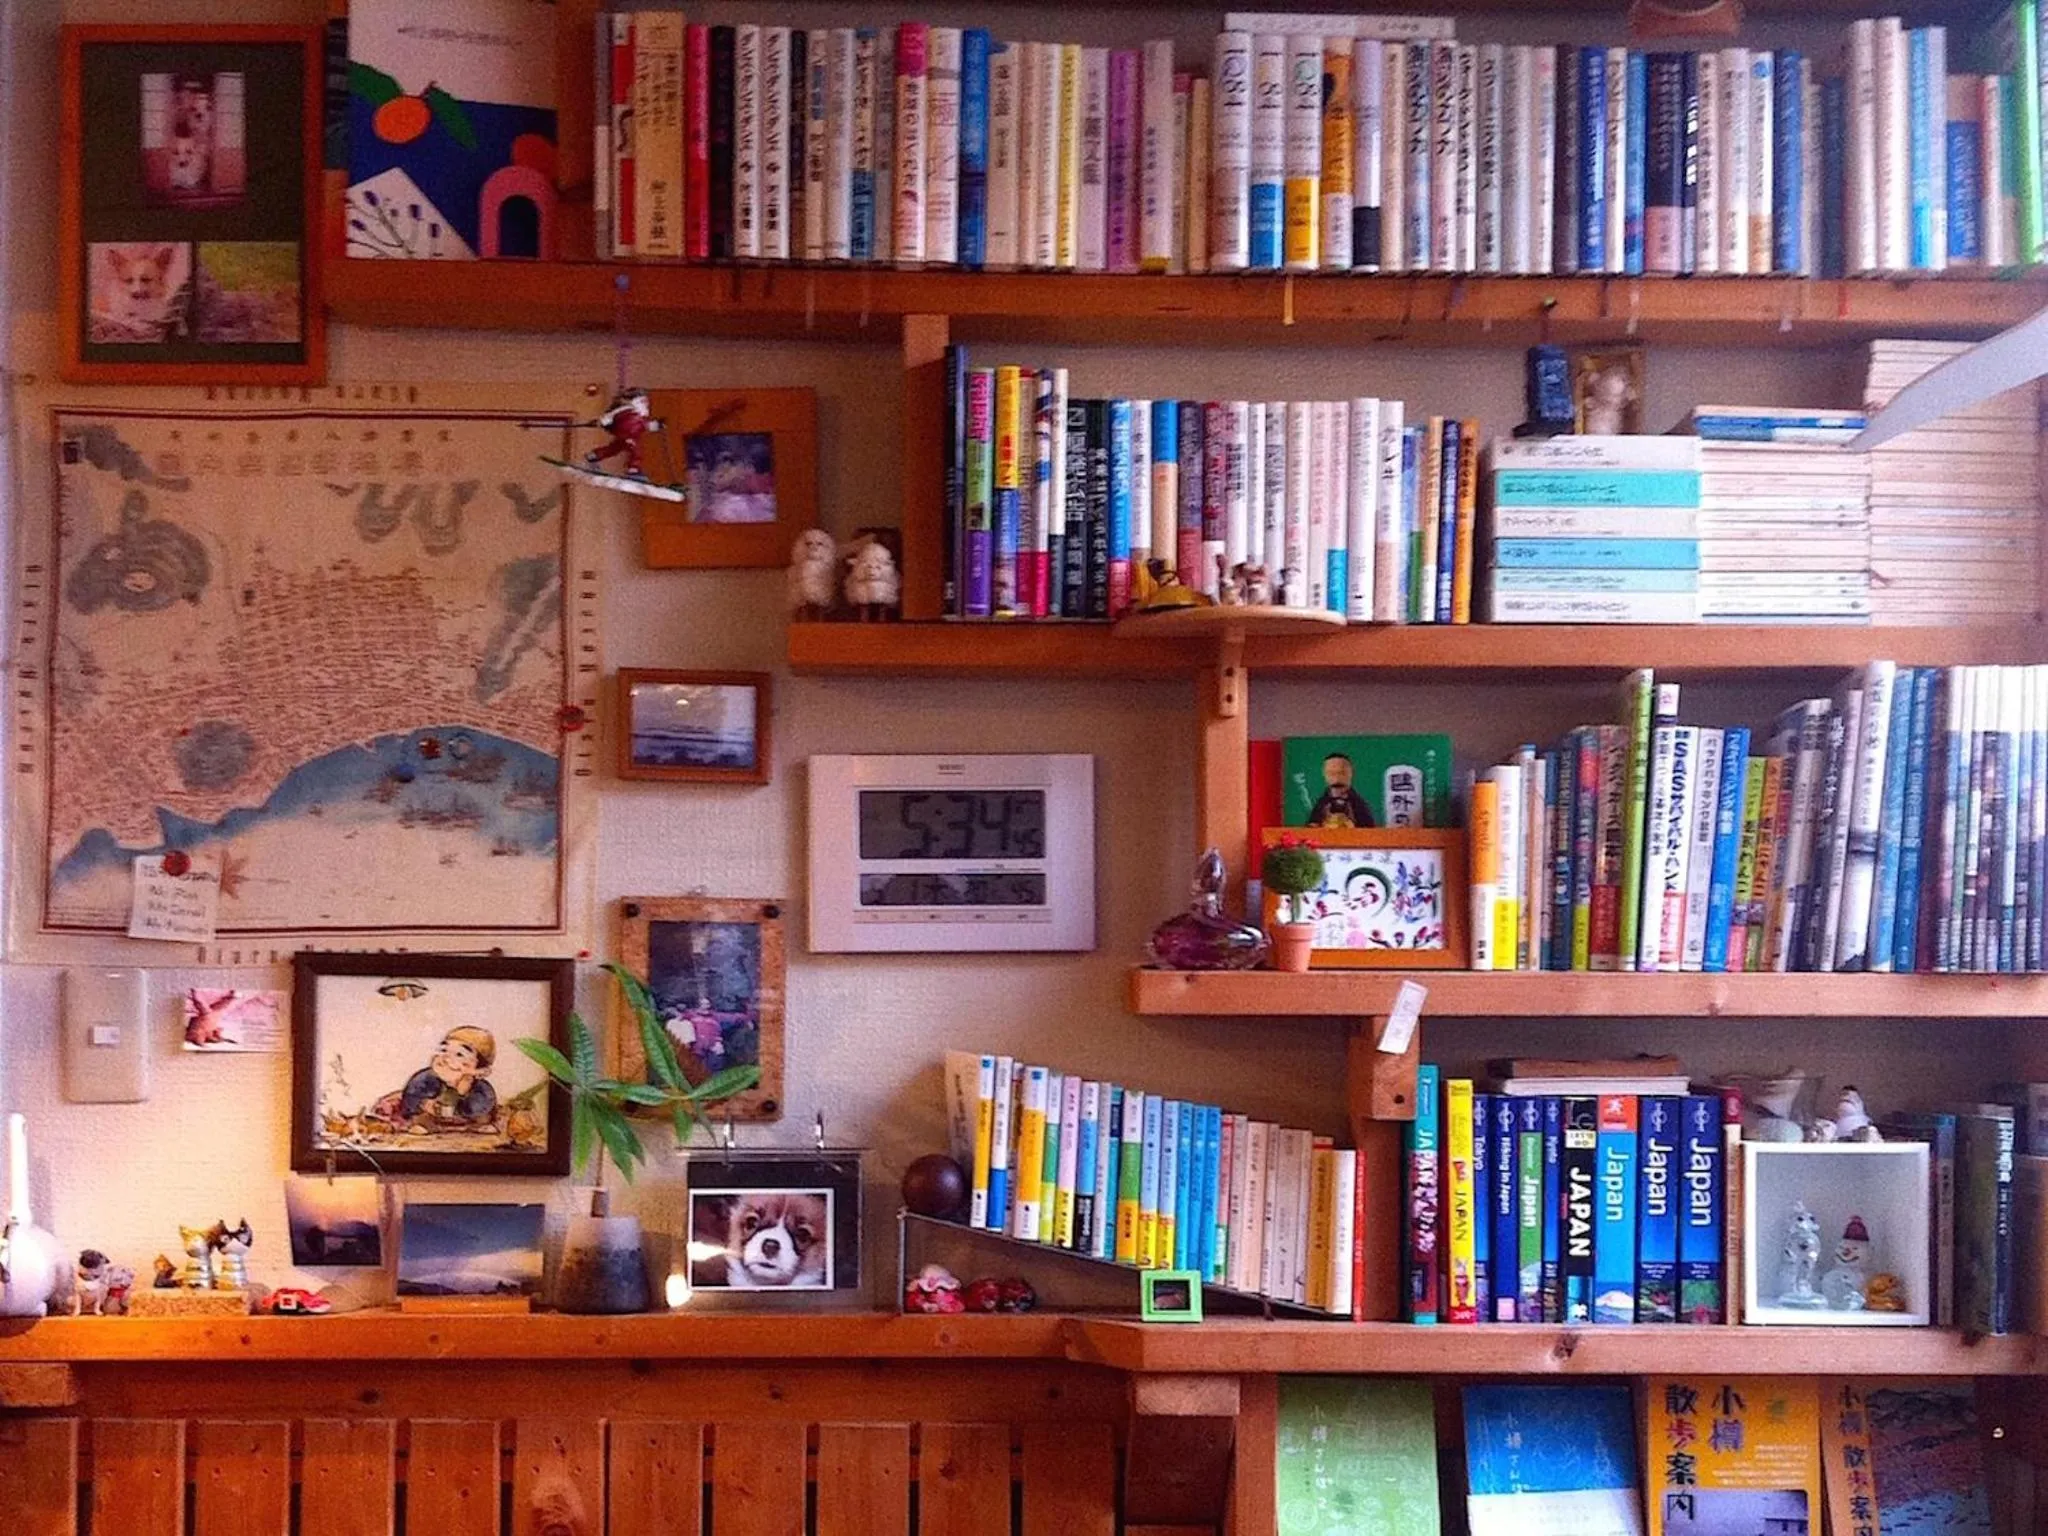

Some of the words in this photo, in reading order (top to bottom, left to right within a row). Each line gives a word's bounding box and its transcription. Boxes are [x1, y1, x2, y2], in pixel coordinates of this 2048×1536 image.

[901, 794, 1012, 857] 5:34
[1416, 1128, 1438, 1184] JAPAN
[1473, 1135, 1486, 1171] Tokyo
[1499, 1136, 1512, 1170] Hiking
[1547, 1135, 1558, 1164] Kyoto
[1643, 1137, 1673, 1216] Japan
[1499, 1183, 1511, 1214] Japan
[1521, 1174, 1540, 1227] Japan
[1602, 1146, 1629, 1222] Japan
[1684, 1137, 1719, 1226] Japan
[1454, 1191, 1468, 1241] JAPAN
[1568, 1167, 1593, 1257] JAPAN
[1708, 1385, 1746, 1453] 小樽
[1664, 1384, 1699, 1521] 散歩案内
